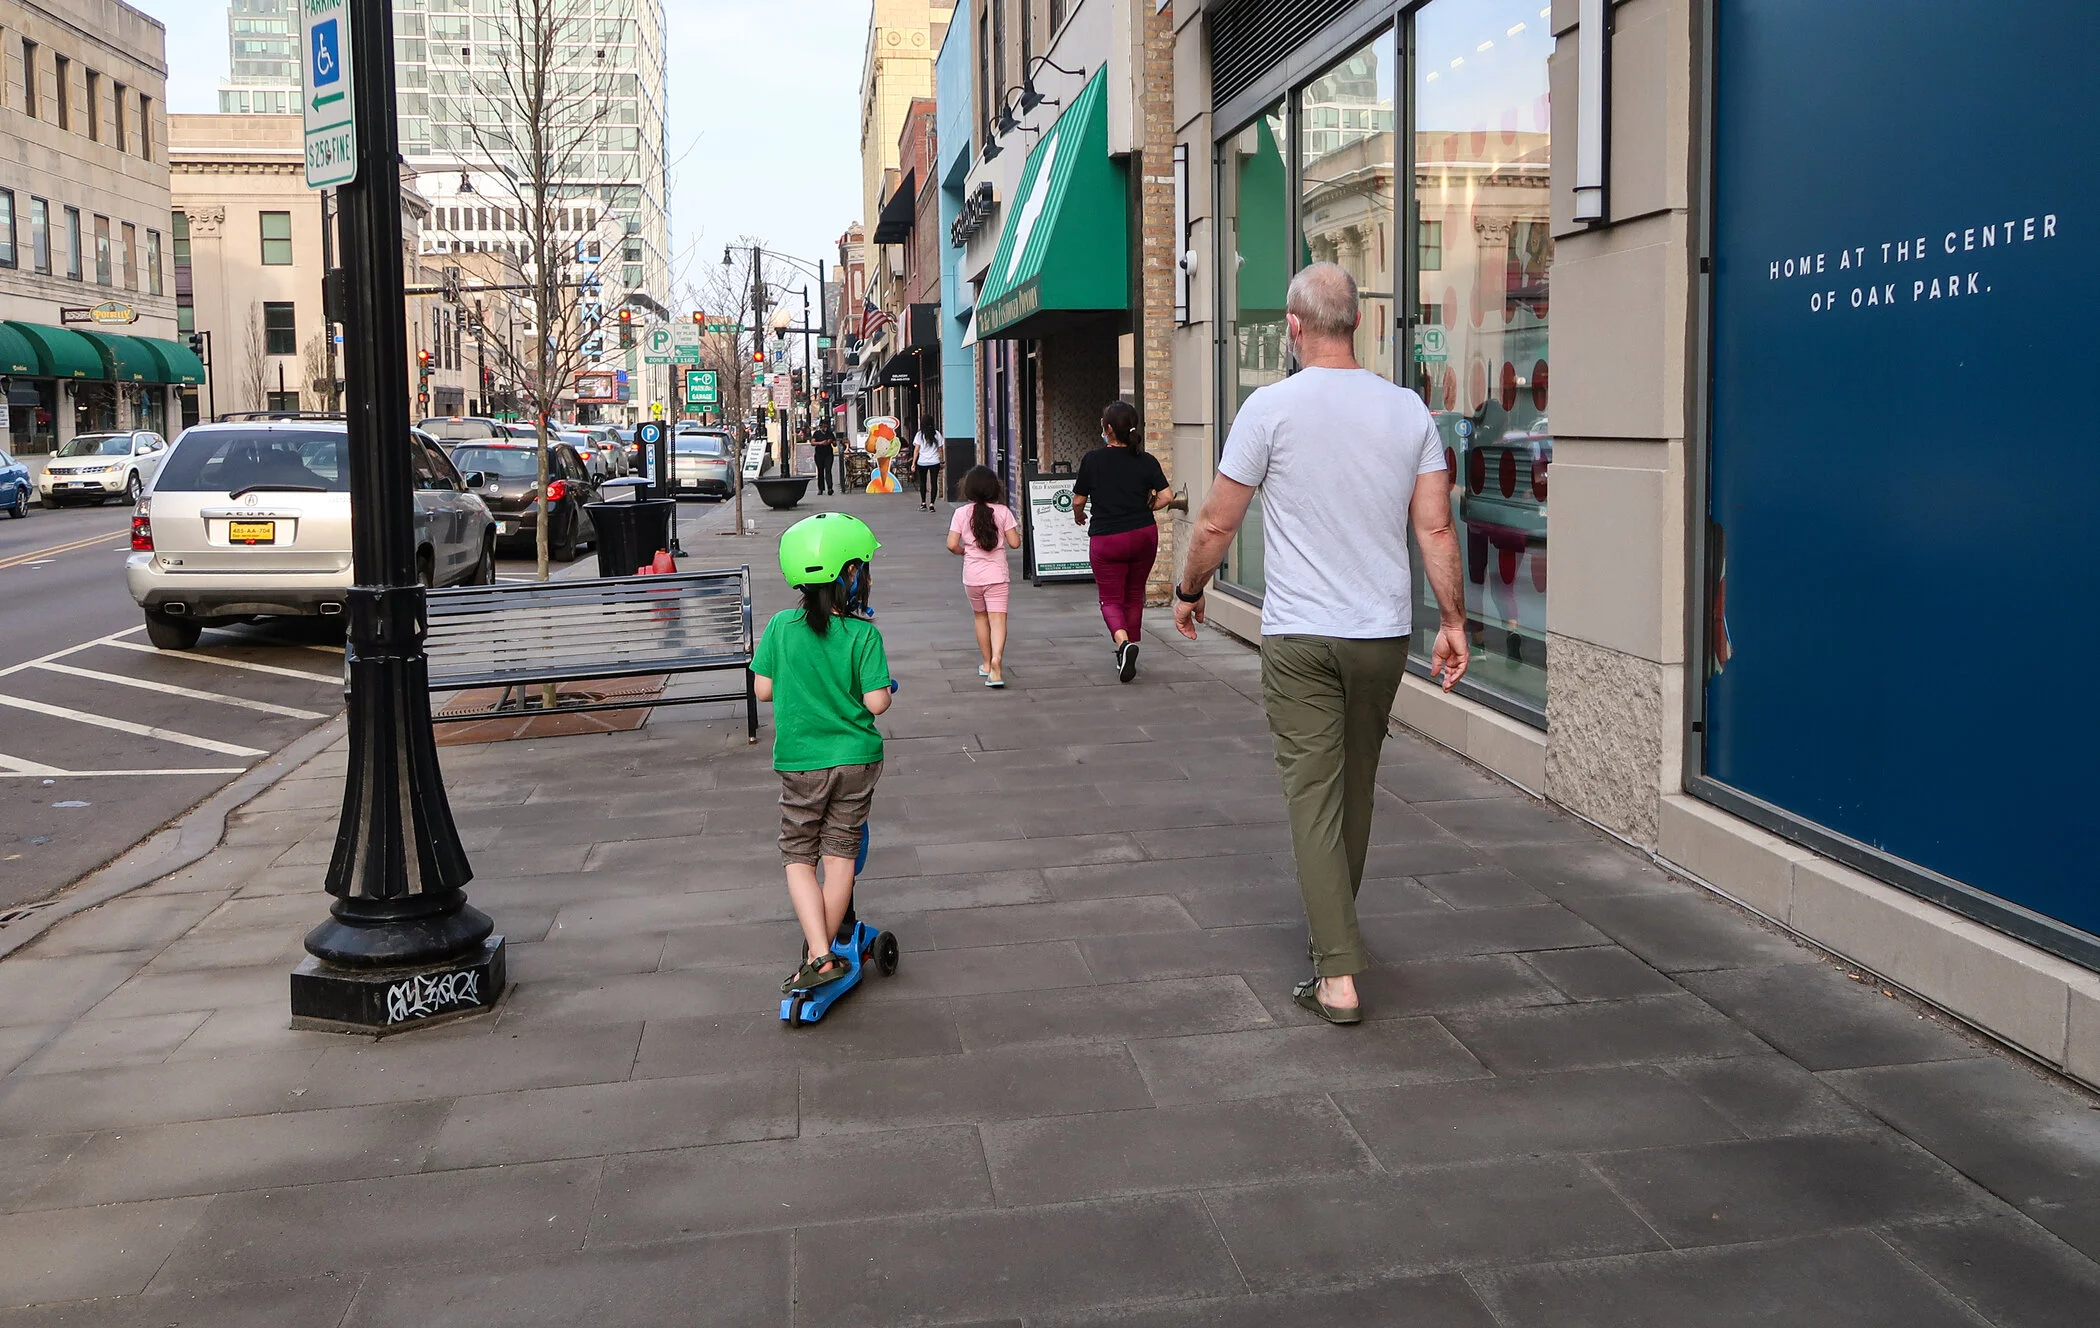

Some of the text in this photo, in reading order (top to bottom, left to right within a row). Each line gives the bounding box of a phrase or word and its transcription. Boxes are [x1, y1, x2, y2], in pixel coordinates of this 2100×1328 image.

[308, 133, 351, 168] $250 FINE
[1770, 214, 2059, 280] HOME AT THE CENTER
[1810, 272, 1992, 312] OF OAK PARK.
[94, 309, 131, 320] POTBELLY
[653, 331, 669, 350] P
